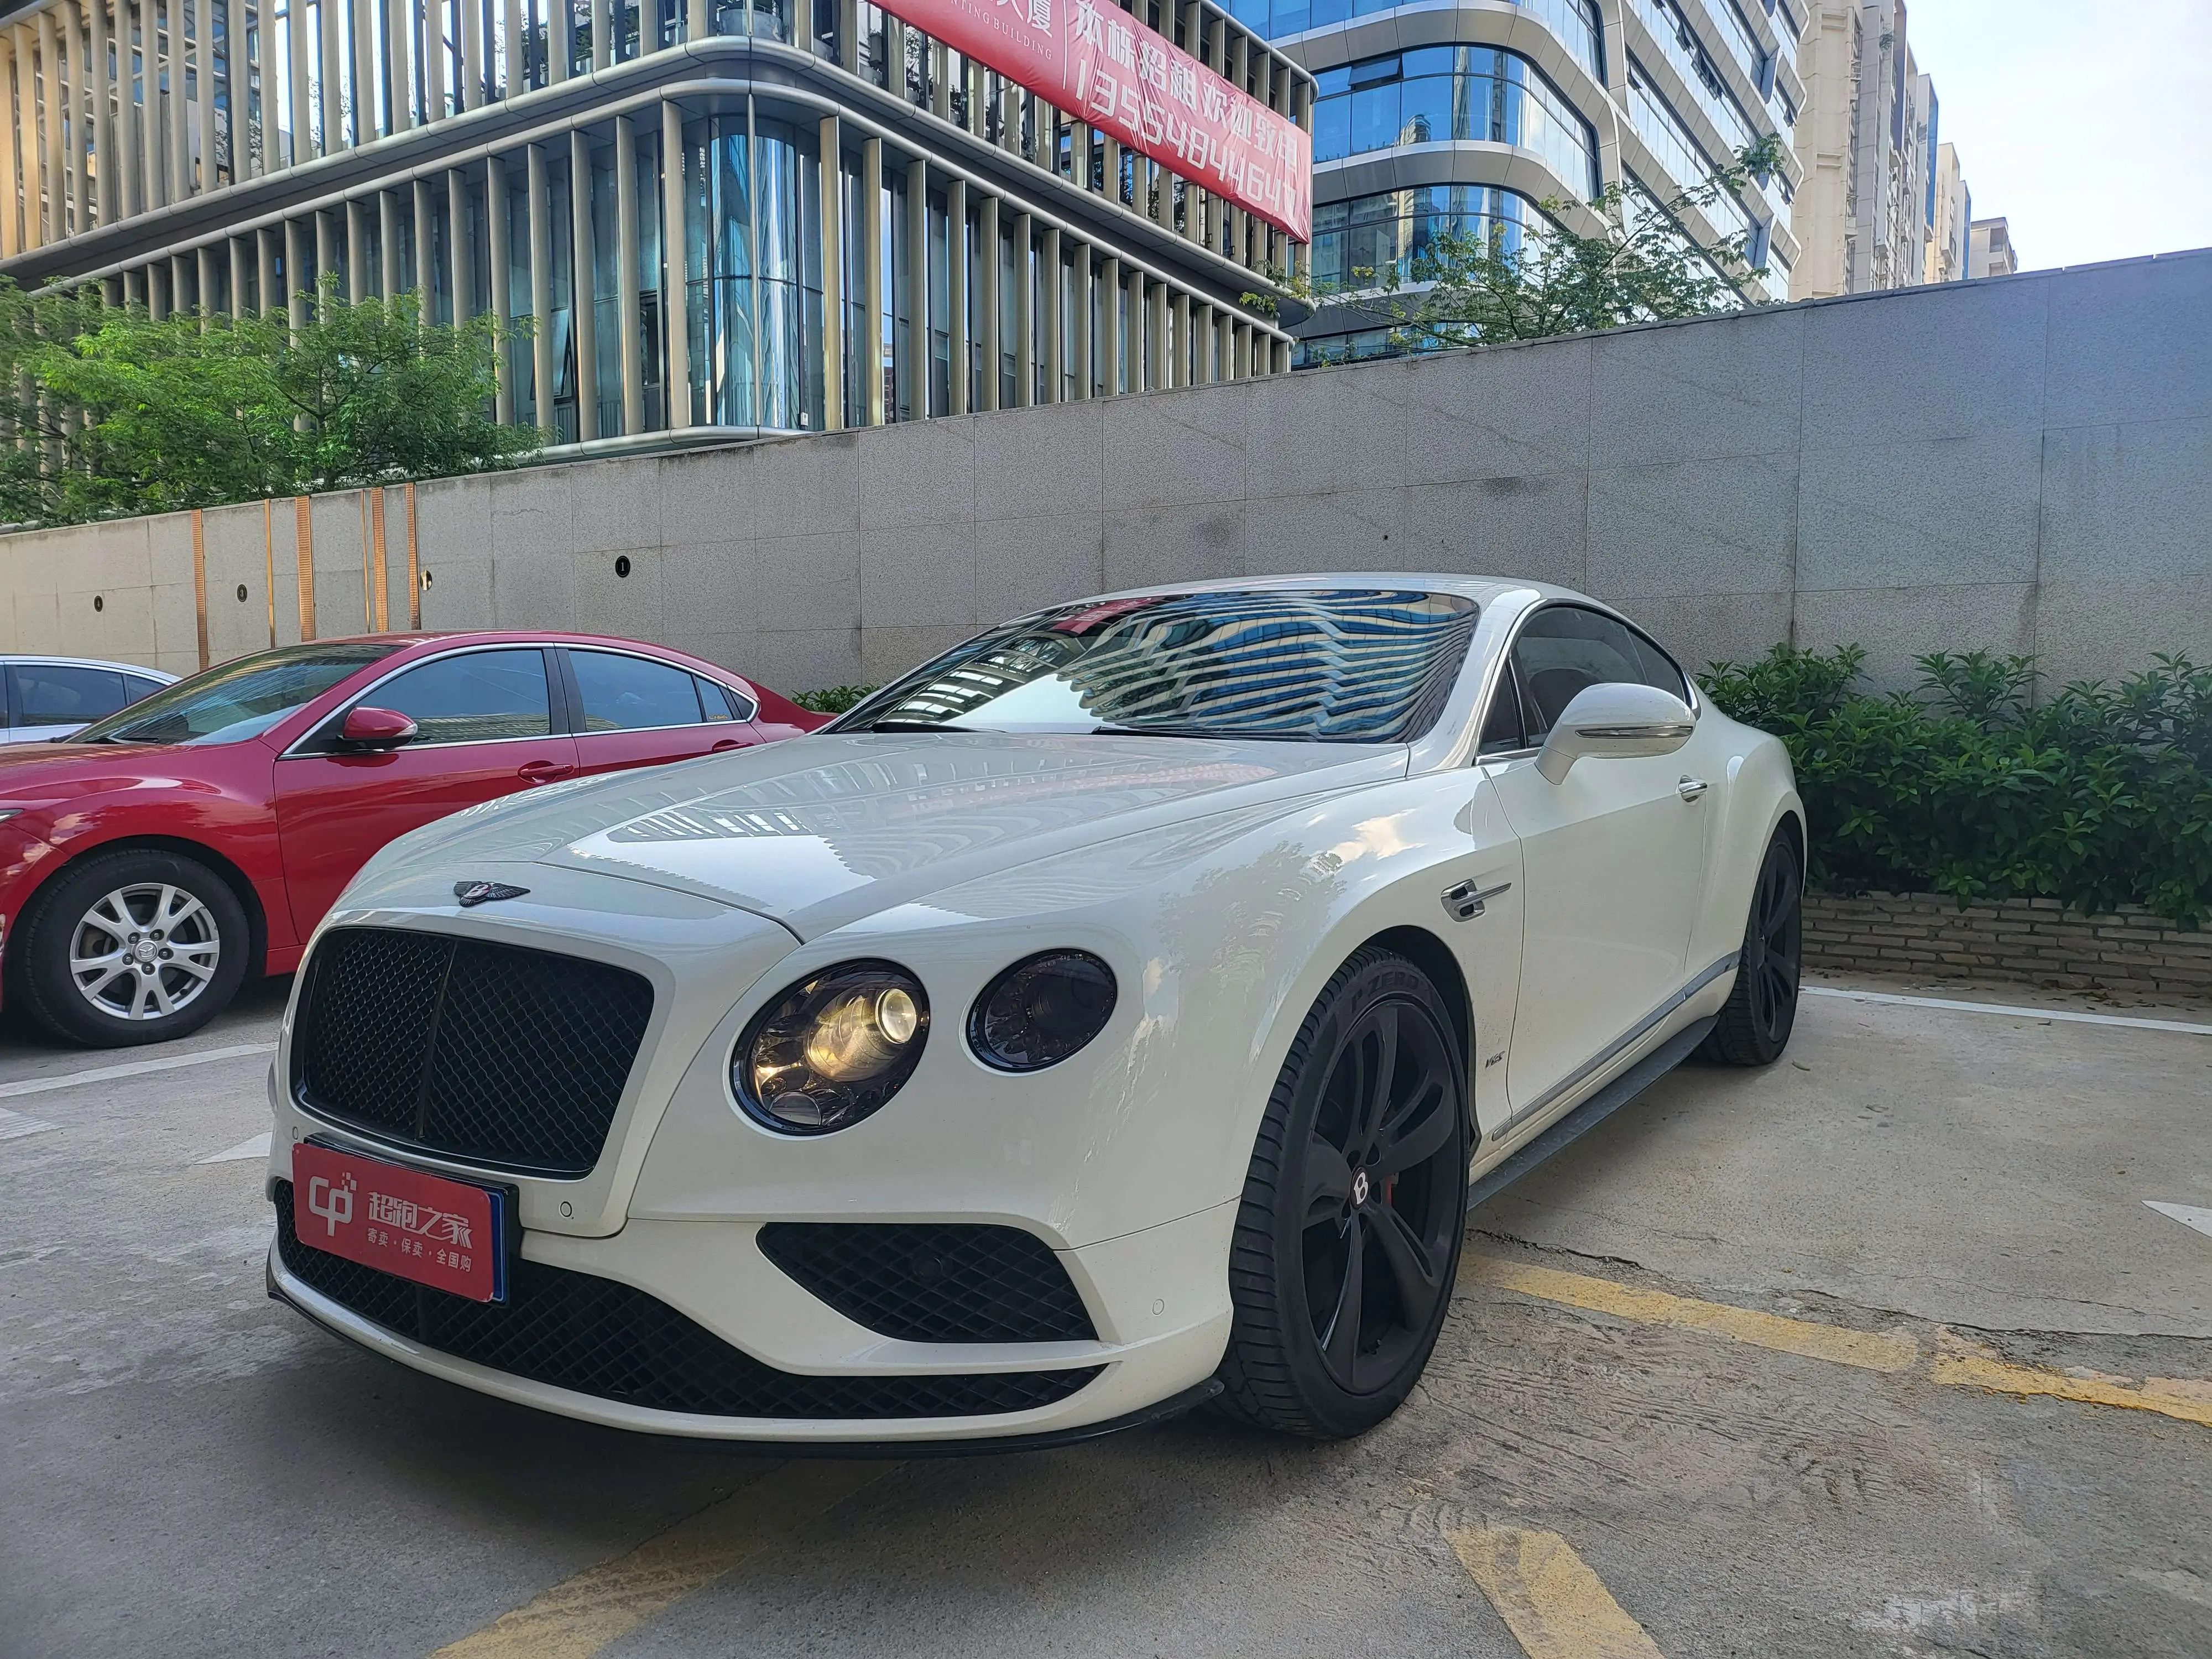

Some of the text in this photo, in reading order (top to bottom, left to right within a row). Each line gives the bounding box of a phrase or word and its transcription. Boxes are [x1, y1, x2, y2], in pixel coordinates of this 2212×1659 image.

[993, 17, 1052, 60] BUILDING
[1076, 59, 1296, 217] 13554844647
[620, 561, 625, 571] 1
[367, 1191, 473, 1249] 超跑之家
